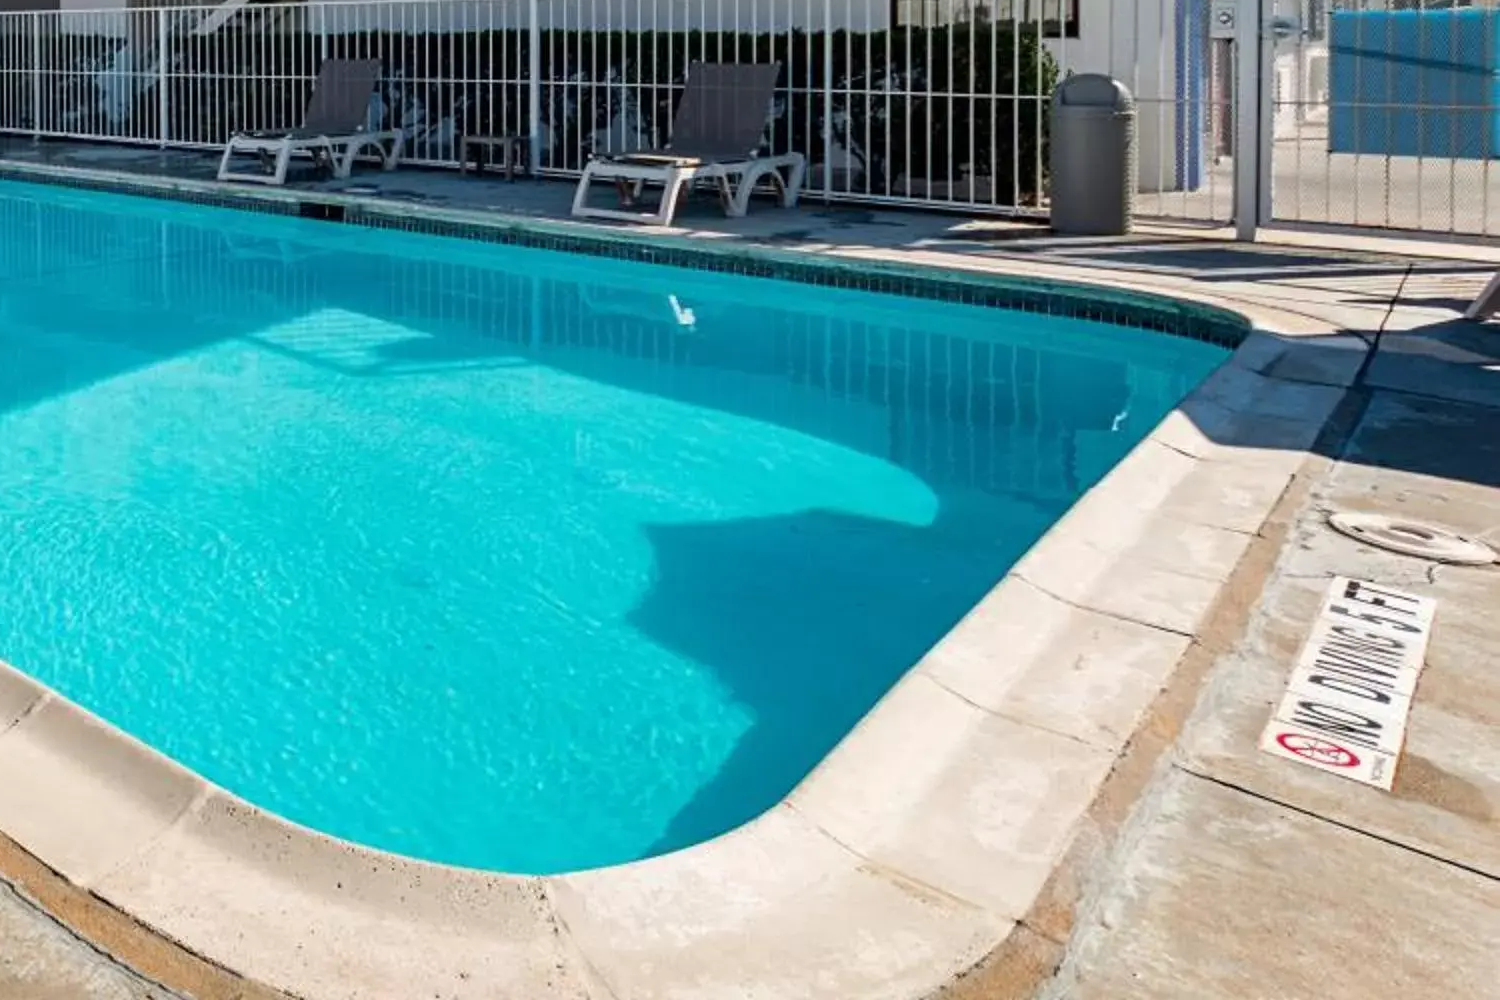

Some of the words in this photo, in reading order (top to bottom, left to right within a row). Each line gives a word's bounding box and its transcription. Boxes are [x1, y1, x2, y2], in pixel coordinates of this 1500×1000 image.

[1343, 580, 1420, 616] FT
[1329, 604, 1422, 633] 5
[1308, 625, 1406, 705] DIVING
[1291, 701, 1383, 746] NO
